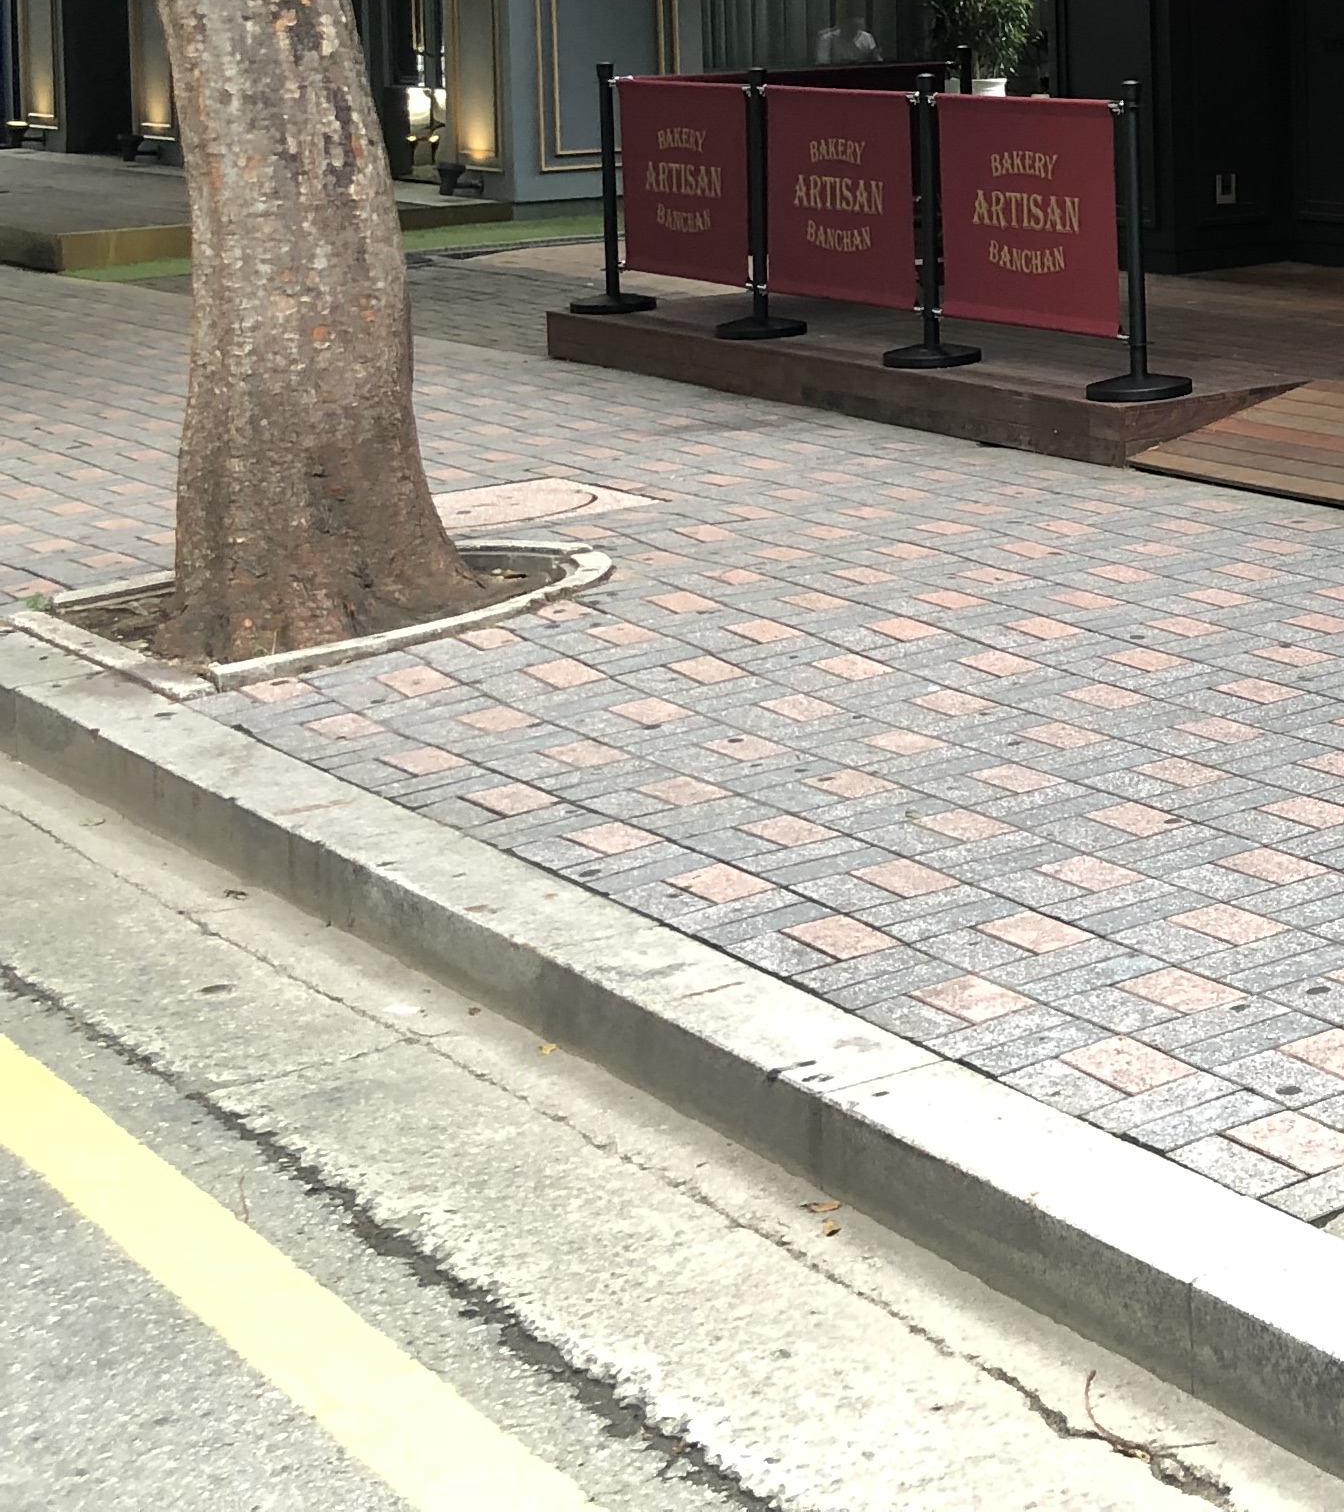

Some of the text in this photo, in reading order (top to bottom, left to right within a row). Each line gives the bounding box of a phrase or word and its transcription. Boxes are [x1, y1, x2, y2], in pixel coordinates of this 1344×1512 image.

[658, 127, 706, 153] BAKERY
[809, 138, 866, 165] BAKERY
[645, 161, 721, 198] ARTISAN
[990, 150, 1058, 180] BAKERY
[794, 174, 884, 216] ARTISAN
[656, 204, 711, 233] BANCHAN
[972, 190, 1080, 235] ARTISAN
[806, 220, 872, 253] BANCHAN
[988, 244, 1066, 276] BANCHAN
